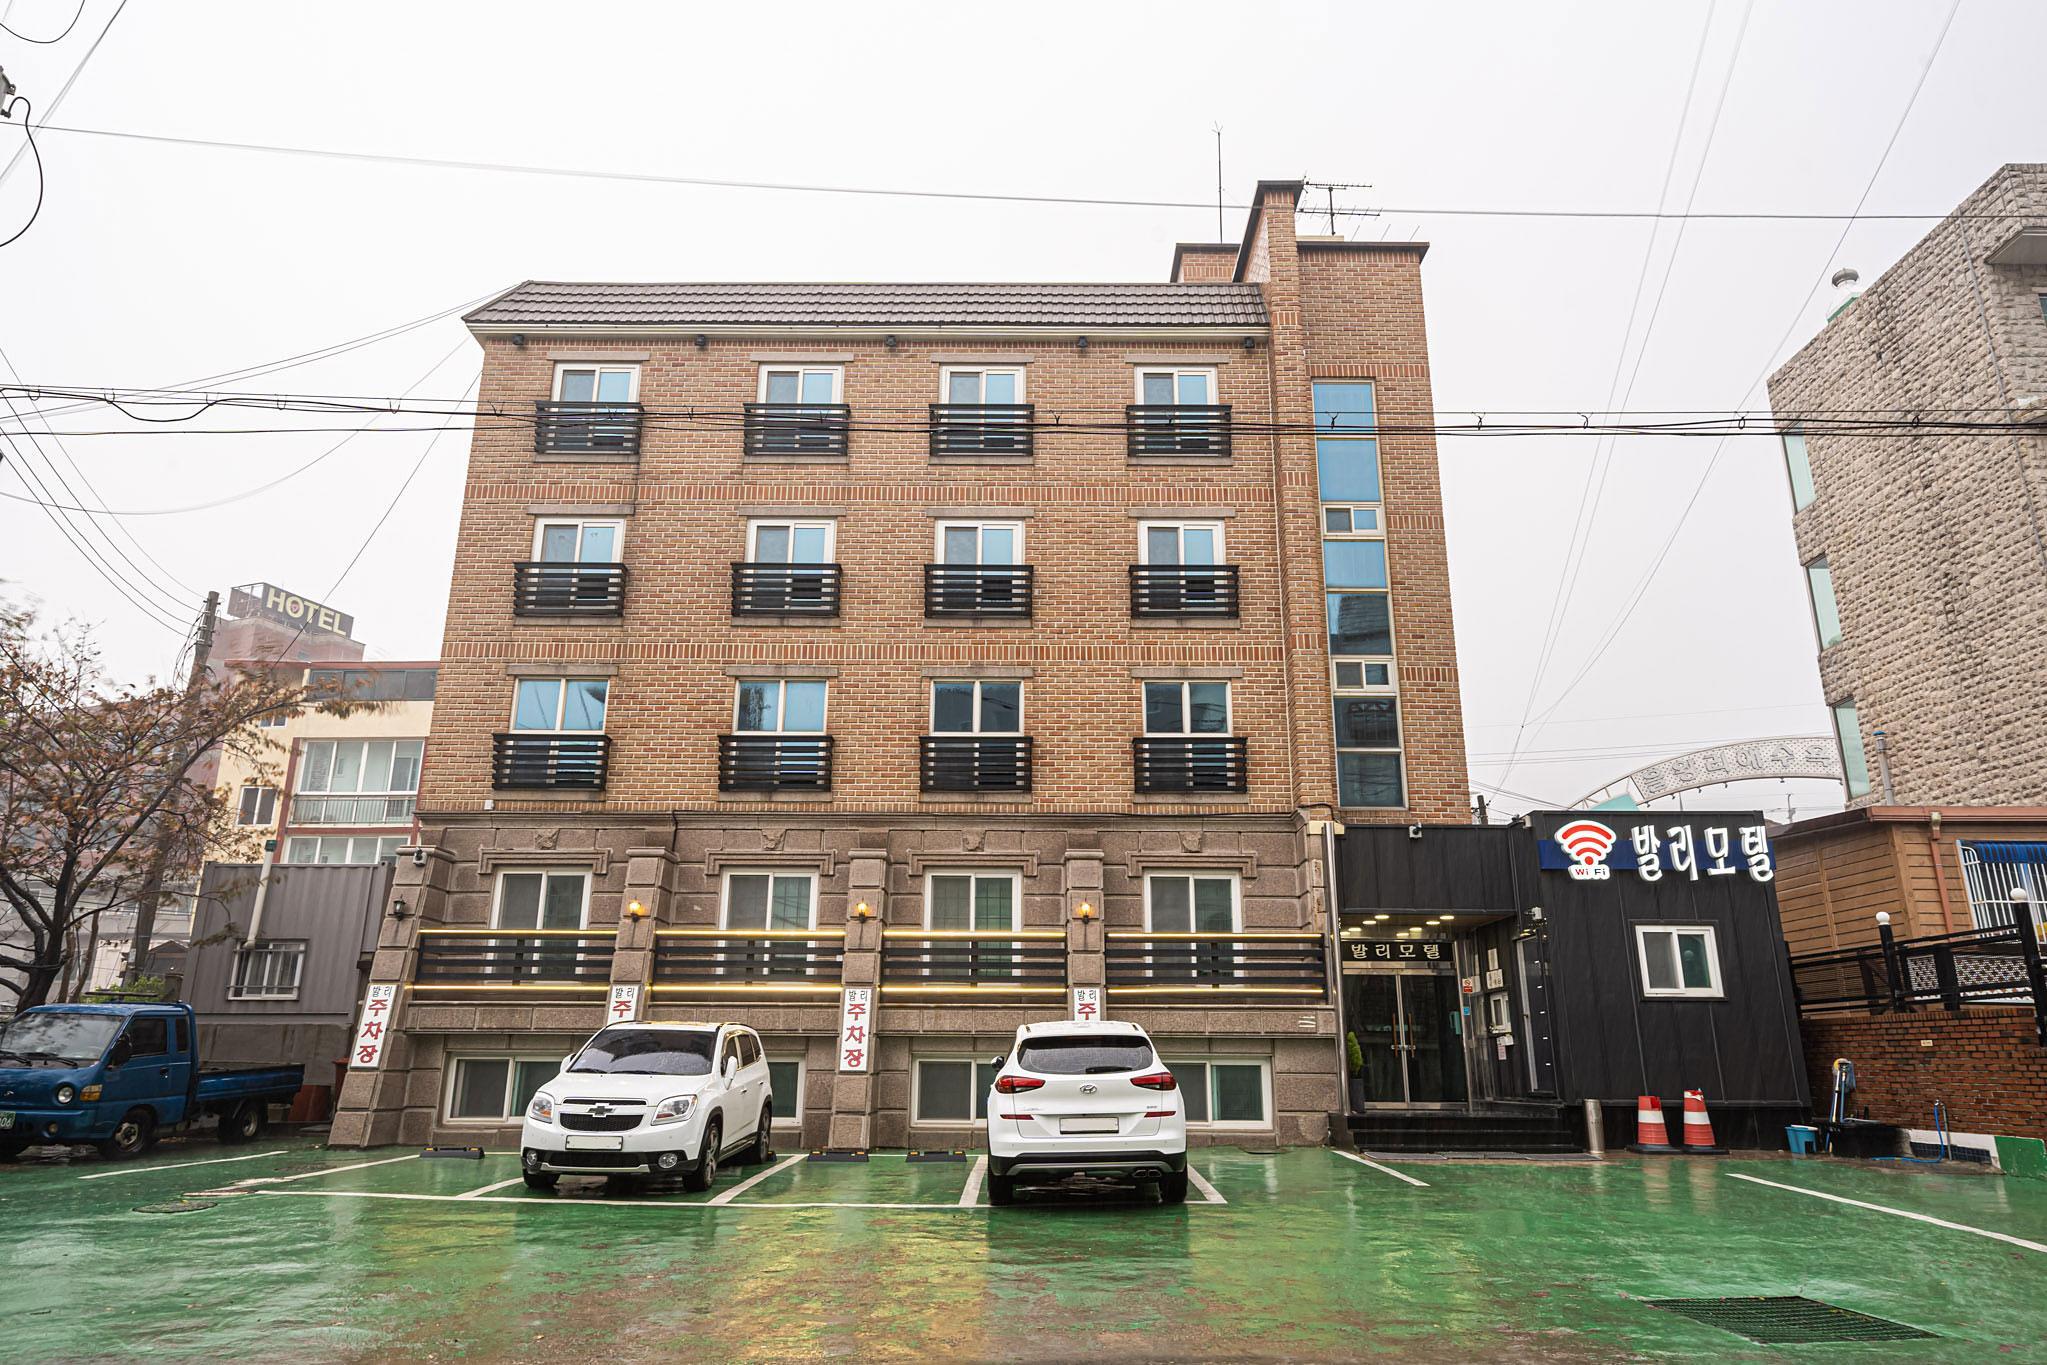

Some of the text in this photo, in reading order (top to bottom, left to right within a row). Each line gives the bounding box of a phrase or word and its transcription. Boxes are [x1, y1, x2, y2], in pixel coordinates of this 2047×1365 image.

[266, 587, 347, 636] HOTEL
[1631, 824, 1774, 882] 발리모텔
[356, 999, 389, 1064] 주차장
[844, 1002, 866, 1068] 주차장
